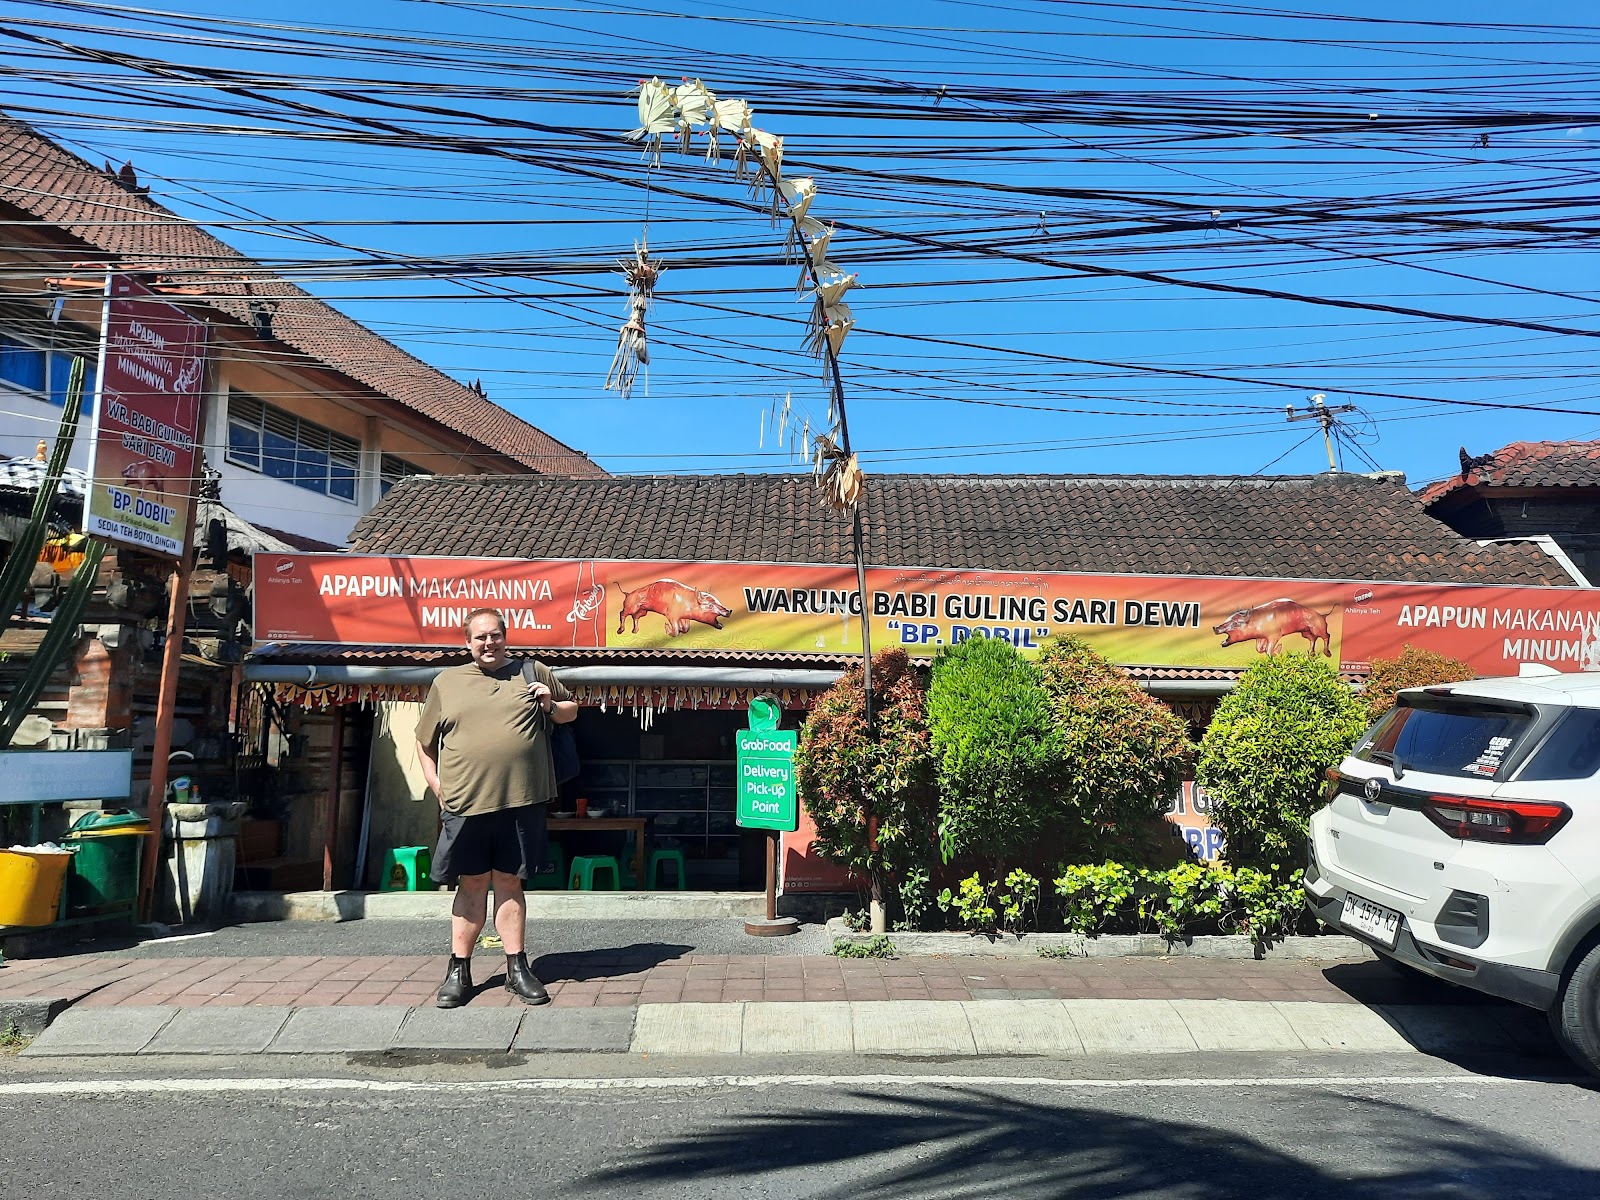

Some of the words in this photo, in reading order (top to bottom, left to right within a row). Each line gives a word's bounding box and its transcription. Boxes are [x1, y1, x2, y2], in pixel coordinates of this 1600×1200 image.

[129, 320, 165, 351] APAPUN
[114, 331, 174, 376] MAKANANNYA
[107, 399, 129, 424] WR.
[131, 409, 156, 435] BABI
[157, 422, 193, 452] GULING
[122, 431, 147, 456] SARI
[148, 442, 177, 468] DEWI
[98, 518, 119, 535] SEDIA
[120, 525, 133, 538] TEH
[134, 529, 154, 544] BOTOL
[155, 535, 177, 550] DINGIN
[319, 574, 404, 598] APAPUN
[409, 576, 553, 601] MAKANANNYA
[421, 606, 552, 630] MINNYA...
[743, 586, 862, 616] WARUNG
[874, 592, 938, 619] BABI
[944, 594, 1047, 623] GULING
[1052, 598, 1116, 625] SARI
[1124, 602, 1201, 628] DEWI
[1369, 607, 1381, 615] Teh
[1397, 605, 1487, 629] APAPUN
[740, 738, 791, 752] GrabFood
[743, 764, 789, 782] Delivery
[746, 781, 786, 799] Pick-up
[751, 799, 780, 814] Point
[1345, 896, 1359, 916] DK
[1359, 900, 1383, 926] 1573
[1383, 912, 1398, 933] KZ
